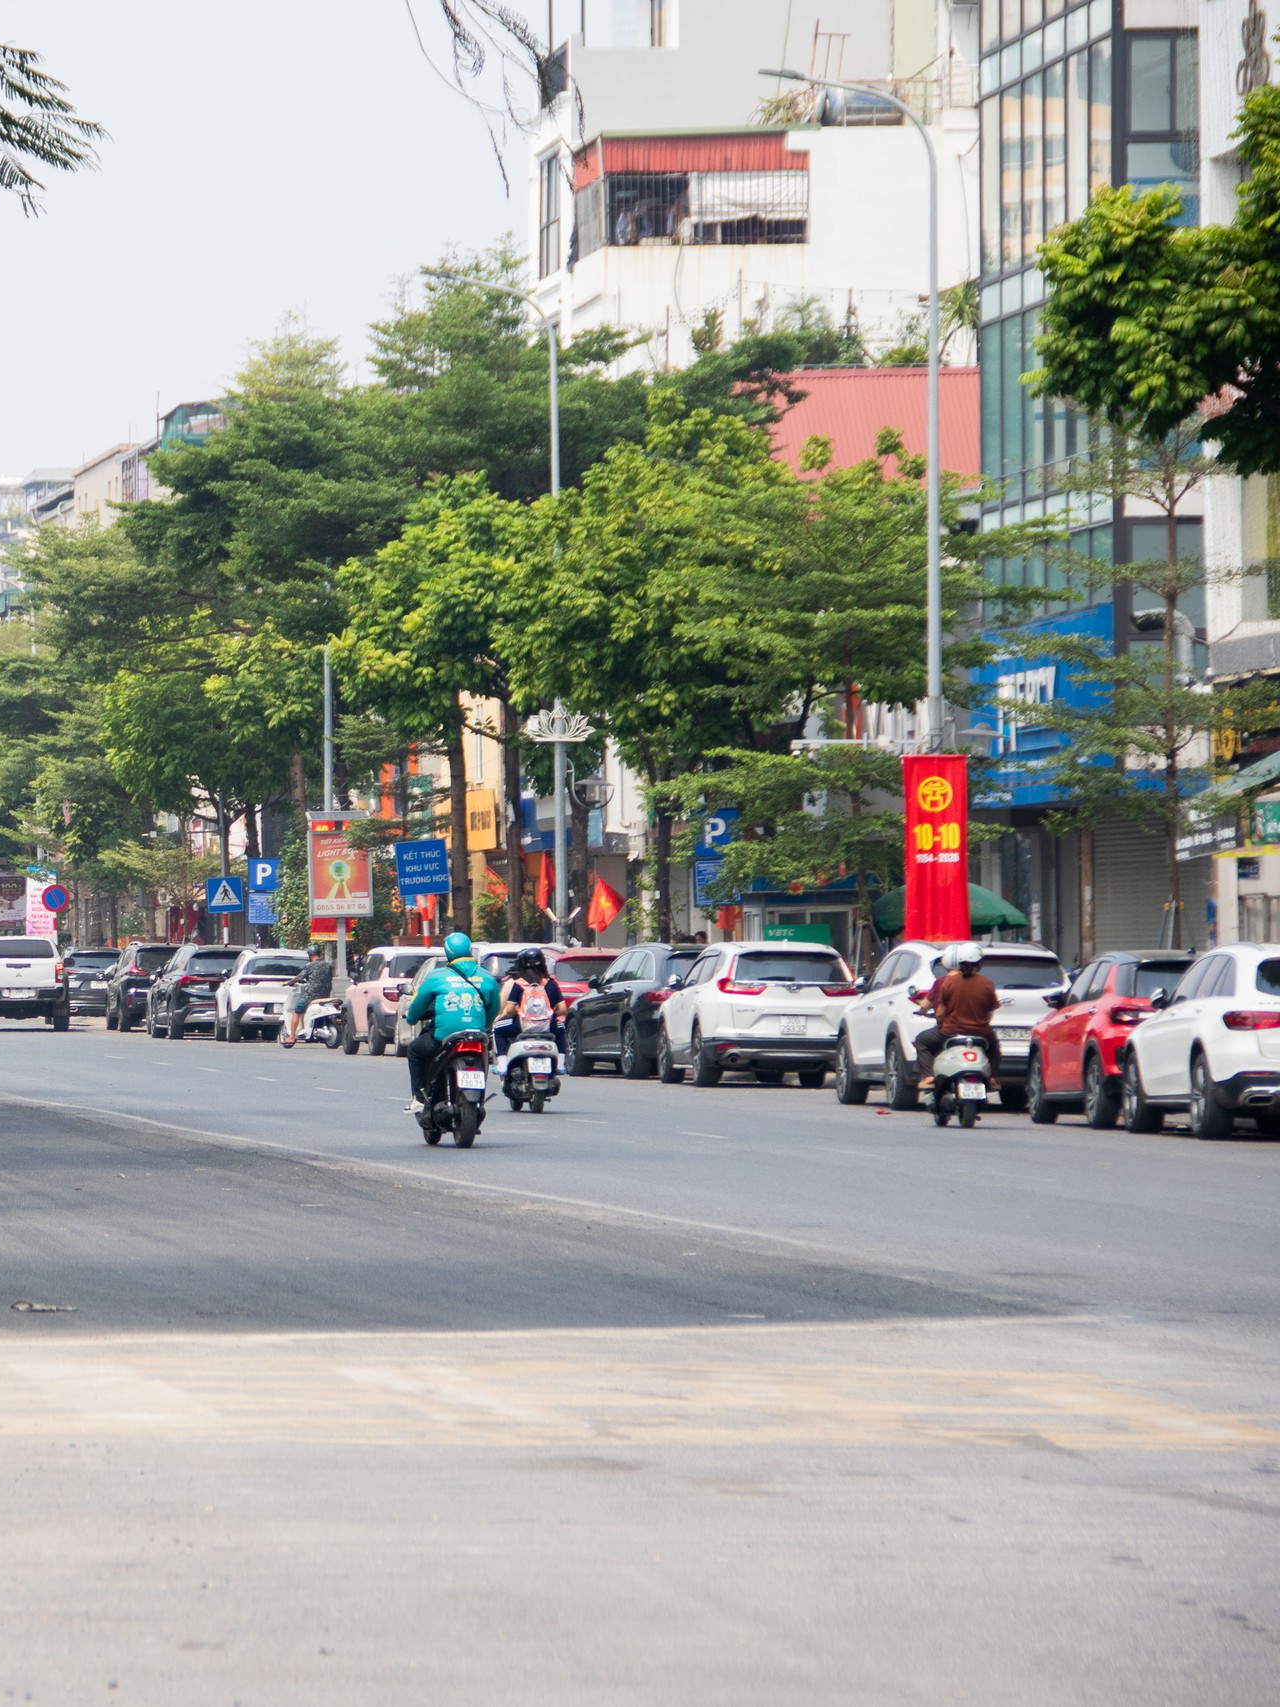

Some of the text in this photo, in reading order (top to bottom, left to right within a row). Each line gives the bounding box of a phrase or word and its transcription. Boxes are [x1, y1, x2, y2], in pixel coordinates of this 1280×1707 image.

[913, 822, 961, 851] 10-10
[317, 849, 342, 858] LIGHT
[403, 848, 441, 861] KẾT THÚC
[256, 863, 272, 885] P
[405, 862, 440, 873] KHU VỰC
[400, 873, 448, 886] TRƯỜNG HỌC
[768, 929, 795, 937] VETC
